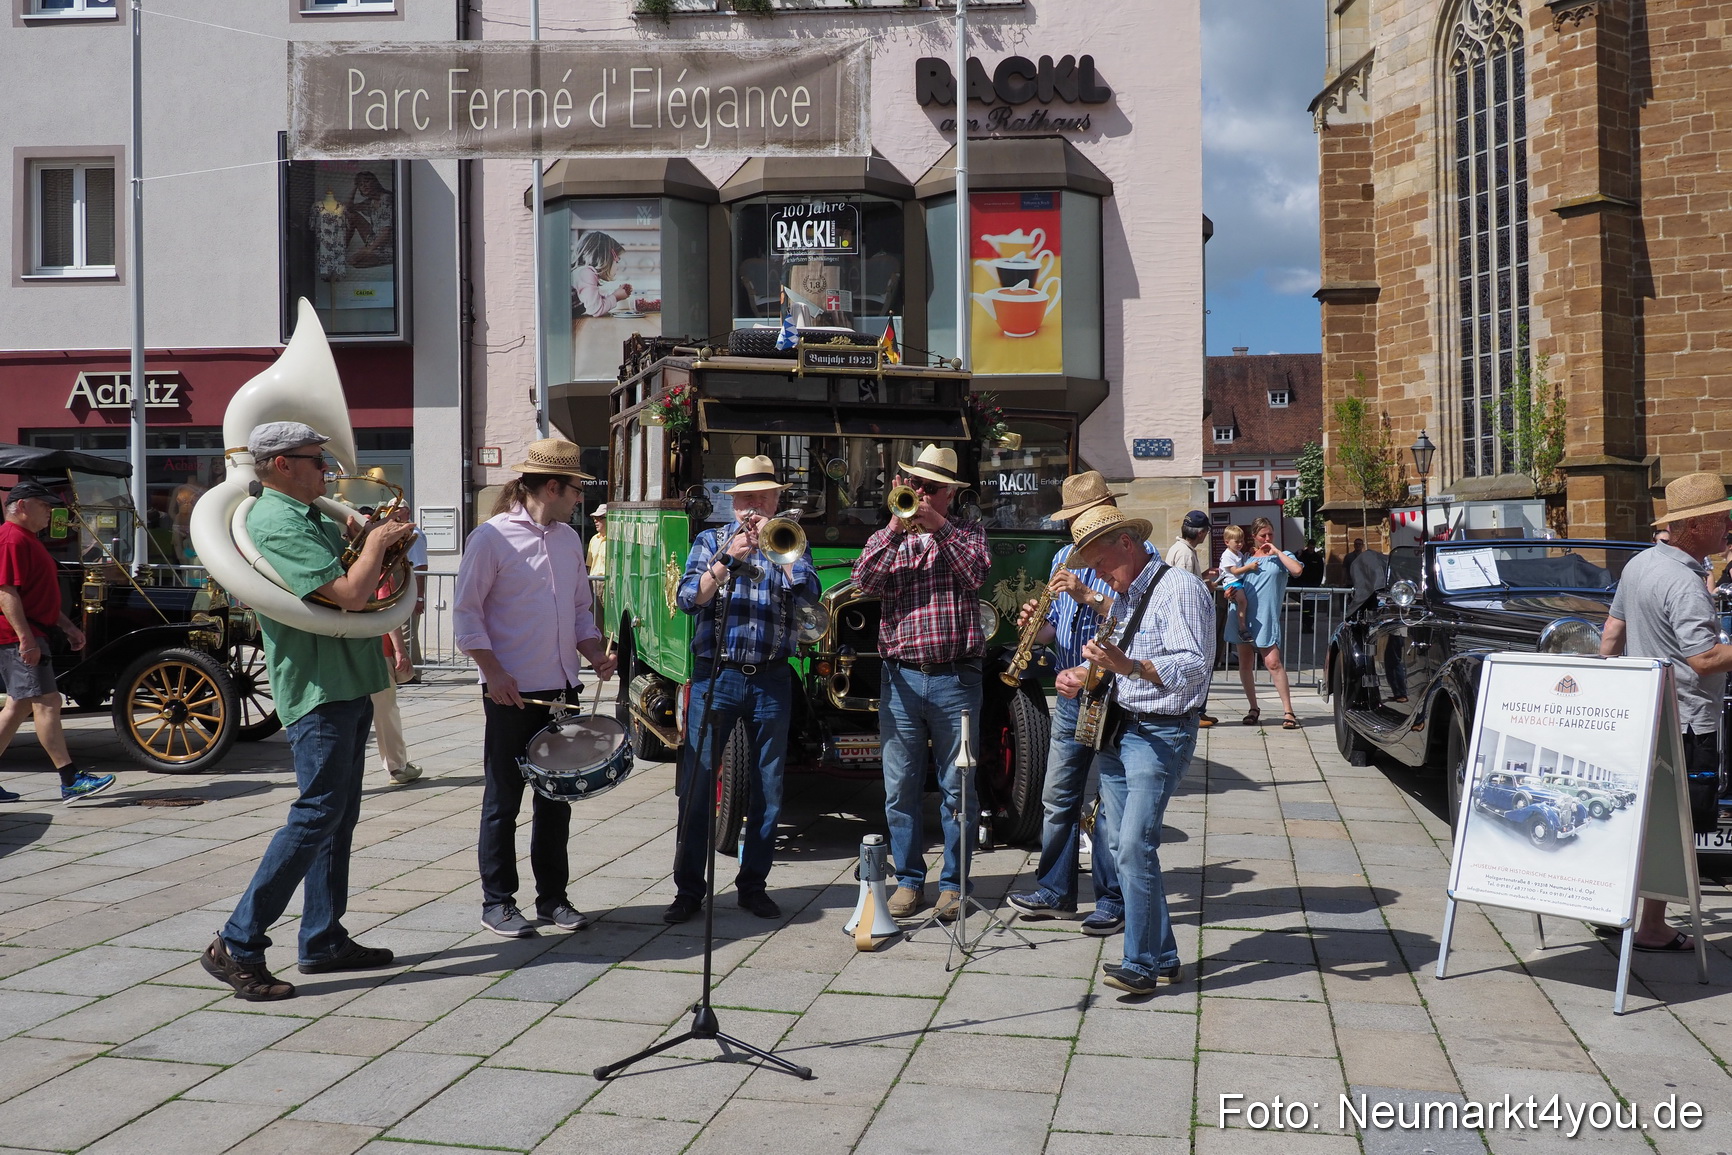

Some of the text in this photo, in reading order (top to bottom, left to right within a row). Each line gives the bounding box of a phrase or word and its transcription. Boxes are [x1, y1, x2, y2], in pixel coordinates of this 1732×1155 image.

[916, 54, 1111, 106] RACKL
[347, 68, 430, 131] Parc
[447, 68, 573, 130] Fermé
[985, 106, 1091, 132] Rathaus
[782, 201, 846, 218] 100 Jahre
[776, 220, 836, 248] RACKL
[809, 353, 873, 366] Baujahr 1923
[65, 371, 179, 409] Achtz
[999, 472, 1039, 492] RACKL
[1501, 702, 1630, 719] MUSEUM FÜR HISTORISCHE
[1510, 715, 1617, 731] MAYBACH-FAHRZEUGE
[1509, 868, 1547, 878] HISTORISCHE
